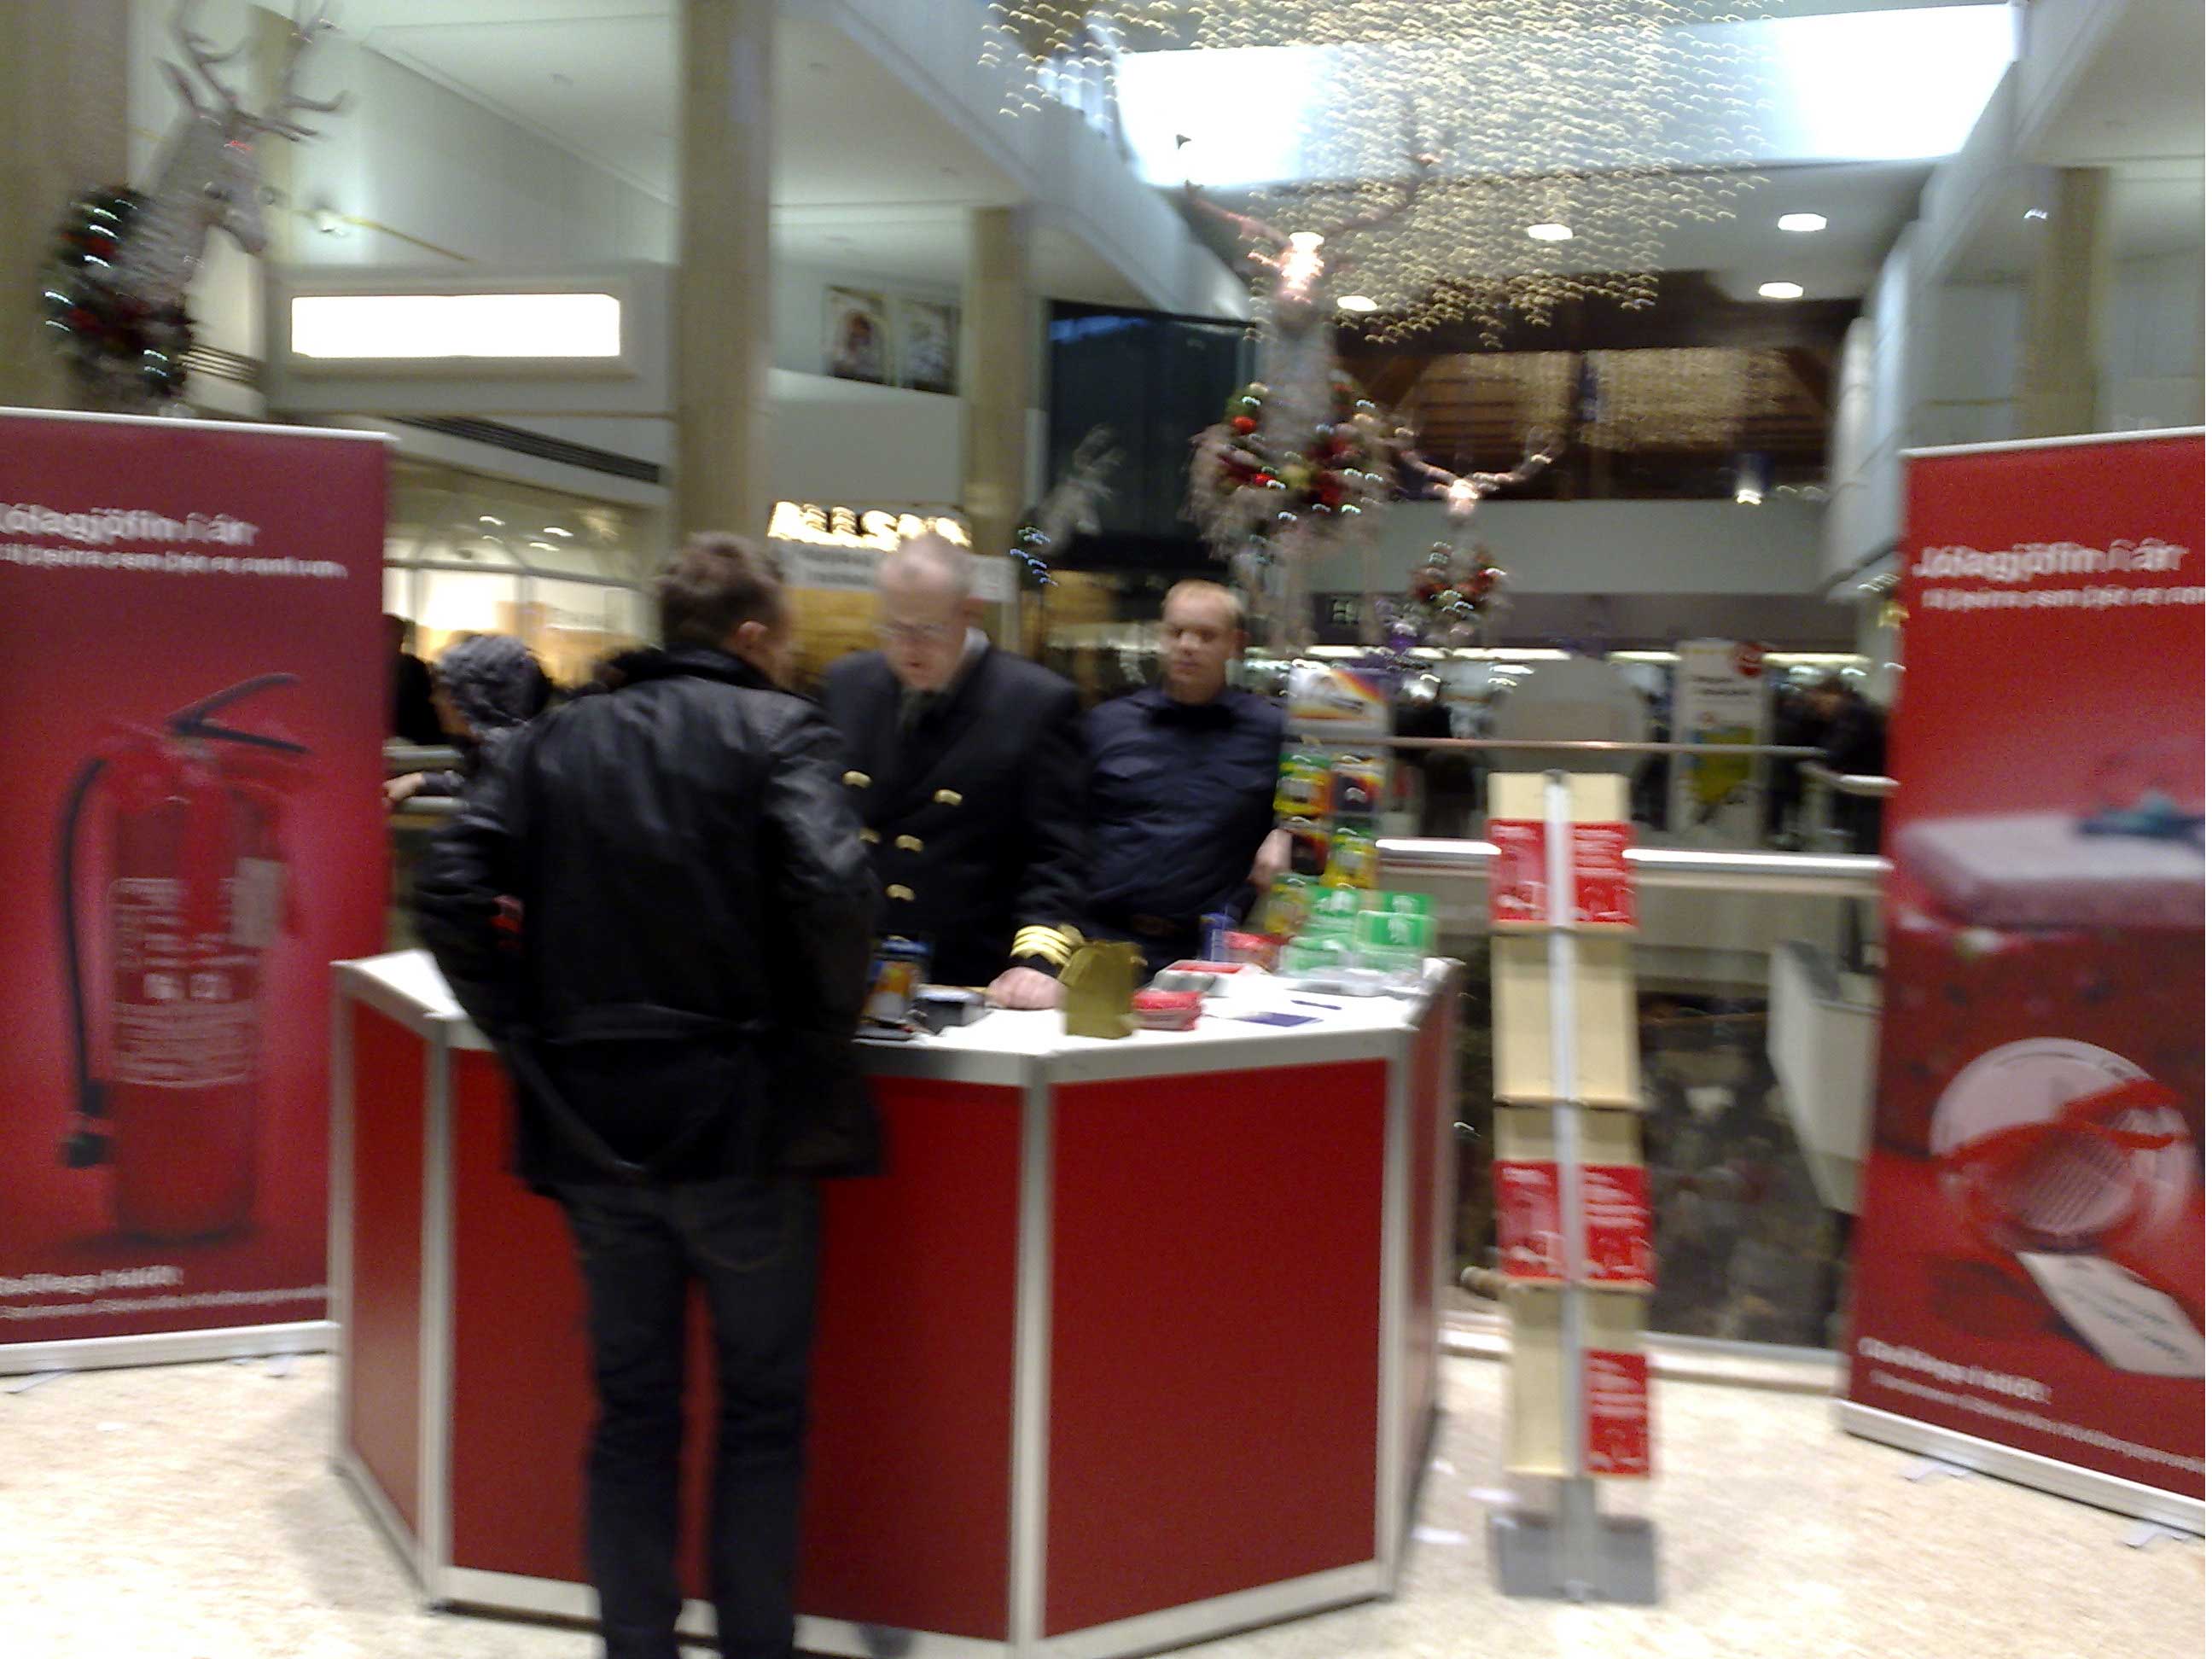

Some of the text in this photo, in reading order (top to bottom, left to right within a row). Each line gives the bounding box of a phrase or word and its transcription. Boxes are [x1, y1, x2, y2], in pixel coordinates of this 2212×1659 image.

[210, 513, 259, 545] ár
[1912, 541, 2105, 583] Jólagjöfin
[2133, 538, 2189, 573] ár
